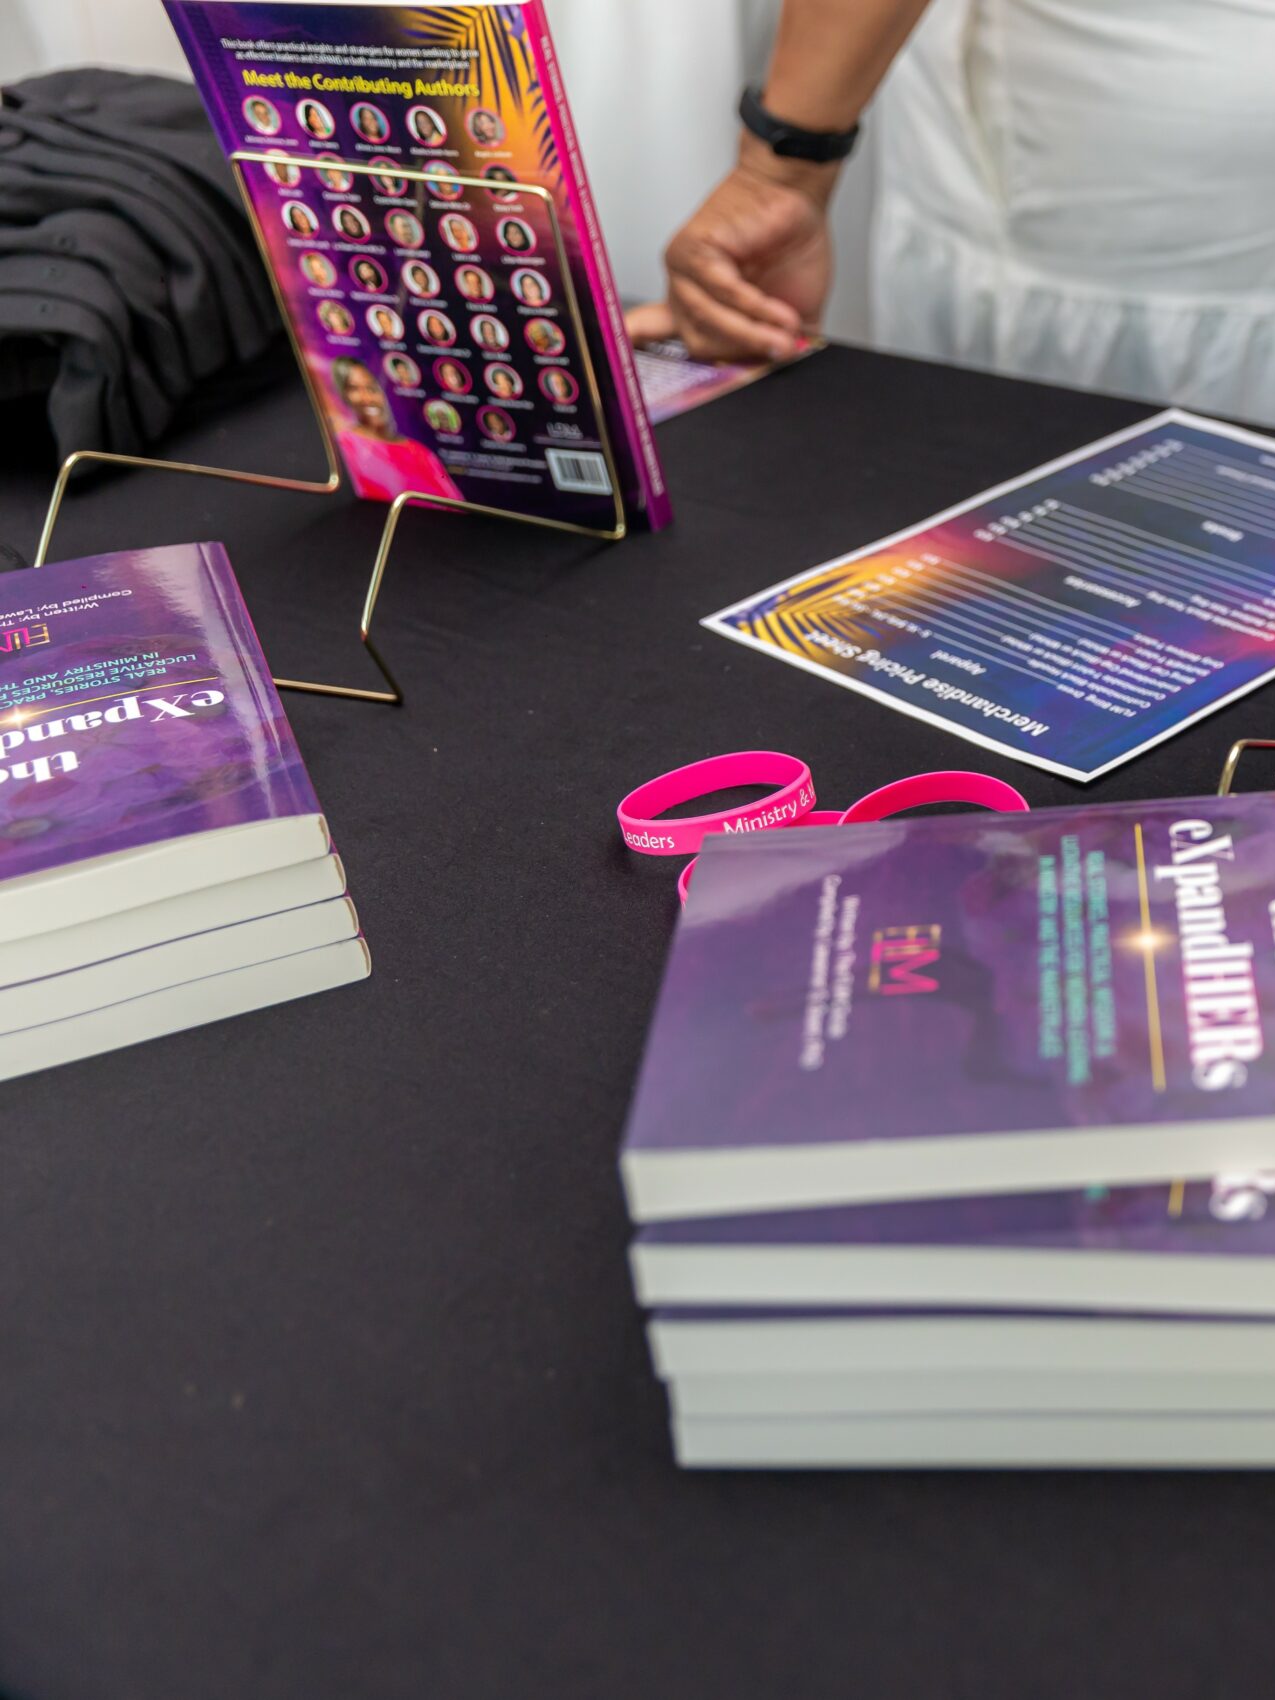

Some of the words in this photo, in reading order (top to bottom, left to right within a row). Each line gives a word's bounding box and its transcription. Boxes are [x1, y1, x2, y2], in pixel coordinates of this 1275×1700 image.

[243, 69, 284, 89] Meet
[286, 72, 312, 91] the
[312, 73, 413, 99] Contributing
[415, 77, 480, 99] Authors
[37, 603, 59, 611] by:
[62, 589, 132, 607] Compiled
[18, 613, 40, 623] by:
[44, 602, 99, 616] Written
[795, 628, 867, 659] Sheet
[63, 656, 138, 677] MINISTRY
[110, 654, 196, 675] LUCRATIVE
[142, 652, 159, 661] IN
[847, 647, 934, 685] Pricing
[925, 648, 992, 677] Apparel
[11, 670, 105, 697] RESOURCES
[23, 672, 59, 686] AND
[50, 675, 120, 695] STORIES,
[125, 667, 166, 682] REAL
[912, 676, 1055, 737] Merchandise
[724, 802, 797, 835] Ministry
[799, 789, 810, 807] &
[1154, 819, 1263, 1091] eXpandHERs
